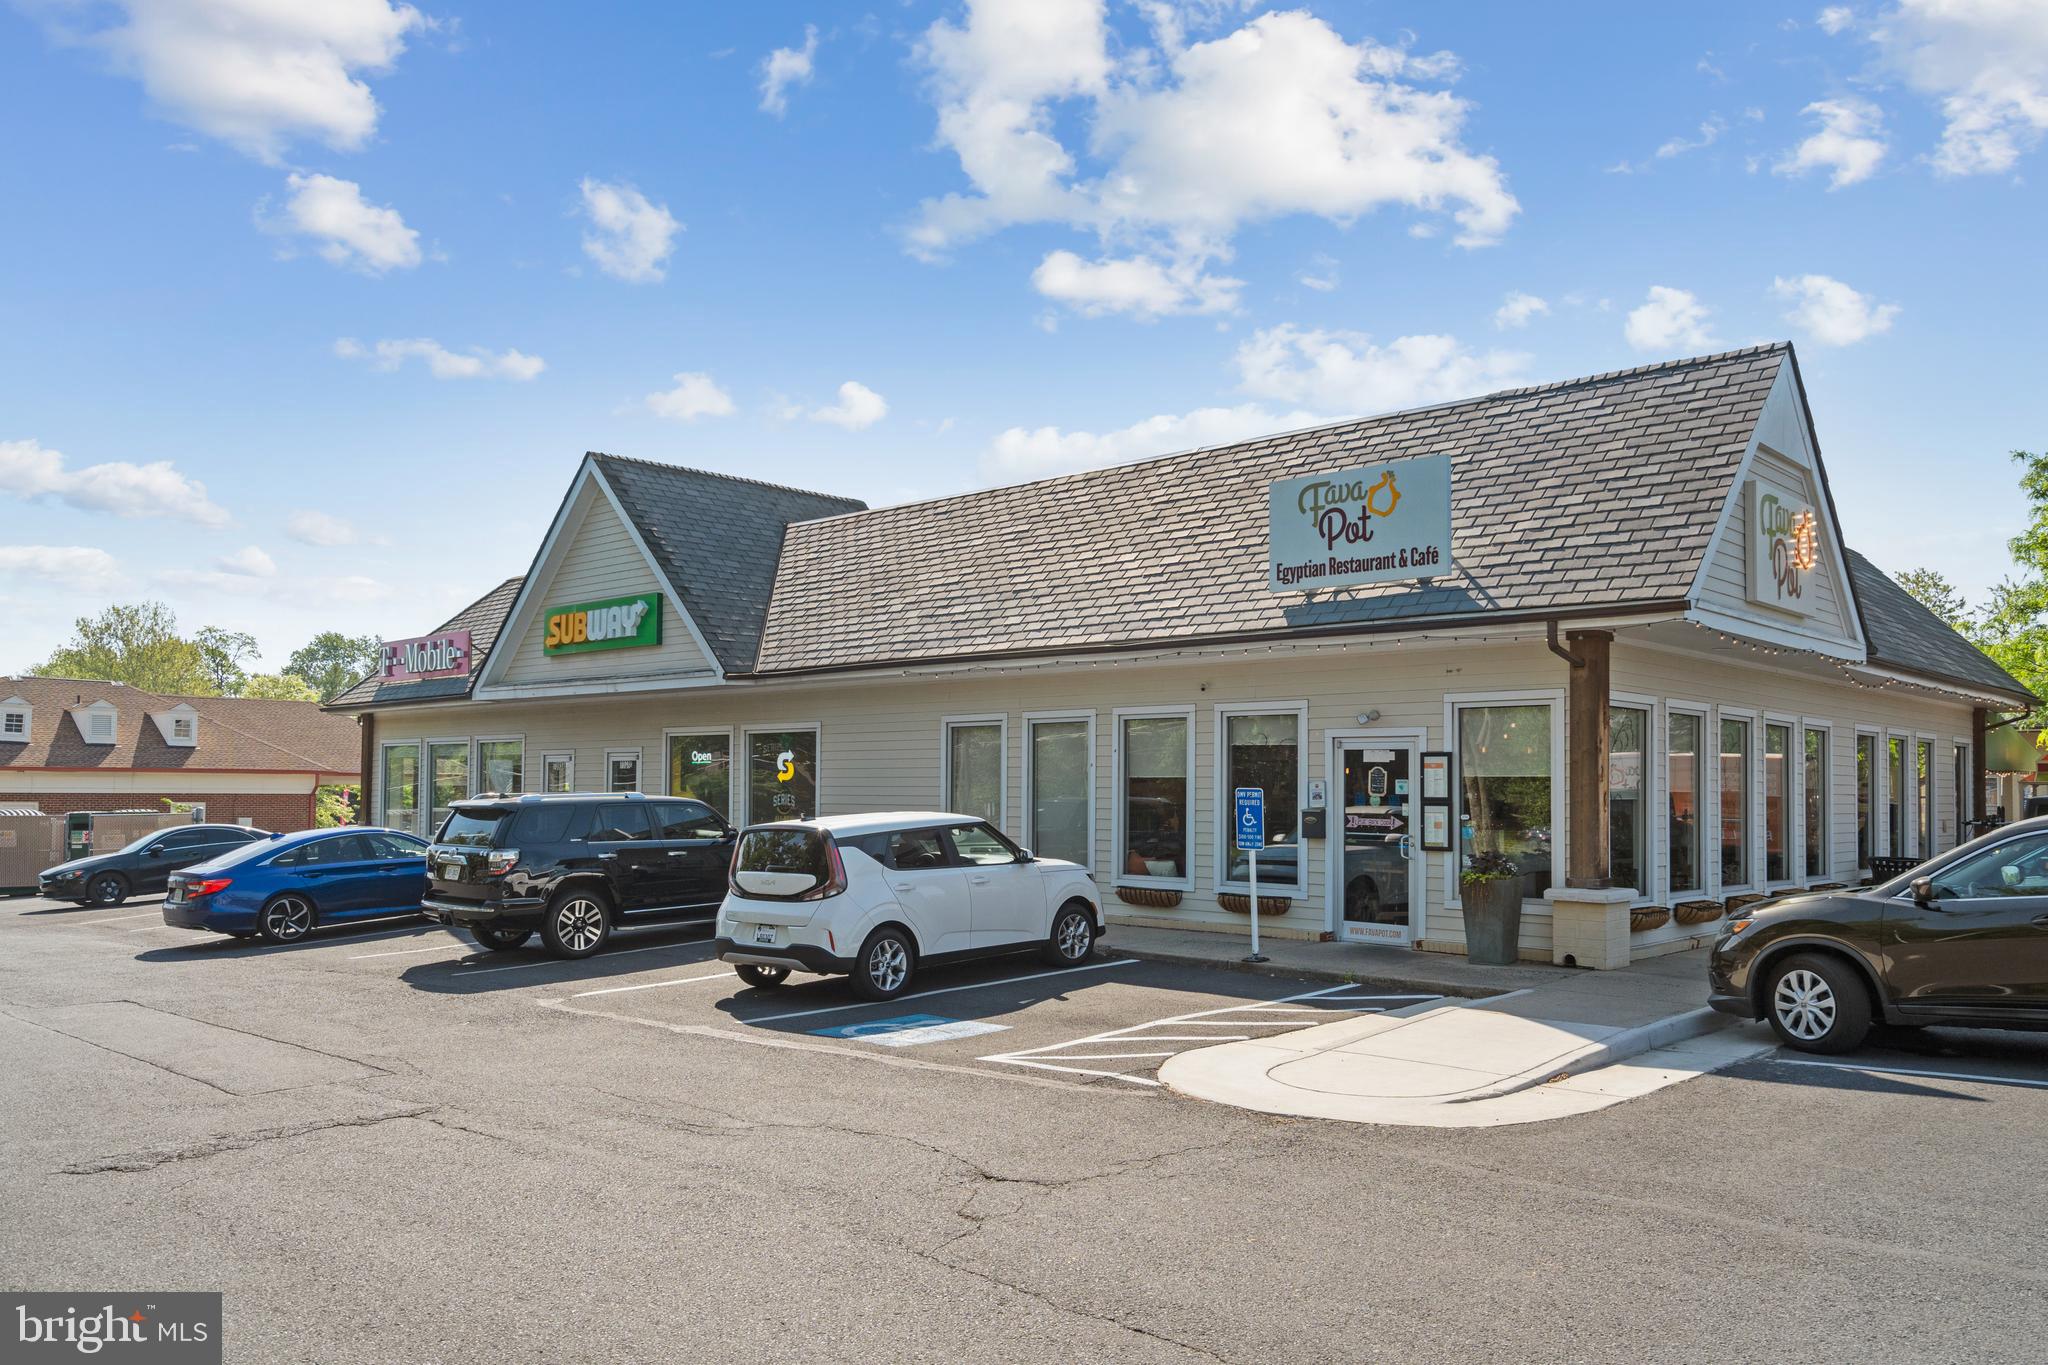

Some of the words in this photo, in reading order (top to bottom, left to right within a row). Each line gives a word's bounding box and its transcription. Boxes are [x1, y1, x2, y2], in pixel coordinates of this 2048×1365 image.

[1298, 480, 1367, 527] Fava
[1319, 505, 1374, 550] Pot
[1760, 494, 1798, 560] Fava
[1276, 560, 1326, 584] Egyptian
[1328, 552, 1396, 575] Restaurant
[1398, 548, 1408, 568] &
[1410, 545, 1439, 567] Café
[1773, 538, 1802, 600] Pot
[545, 600, 648, 649] SUBWAY
[692, 751, 712, 763] Open
[773, 793, 796, 807] SERIES
